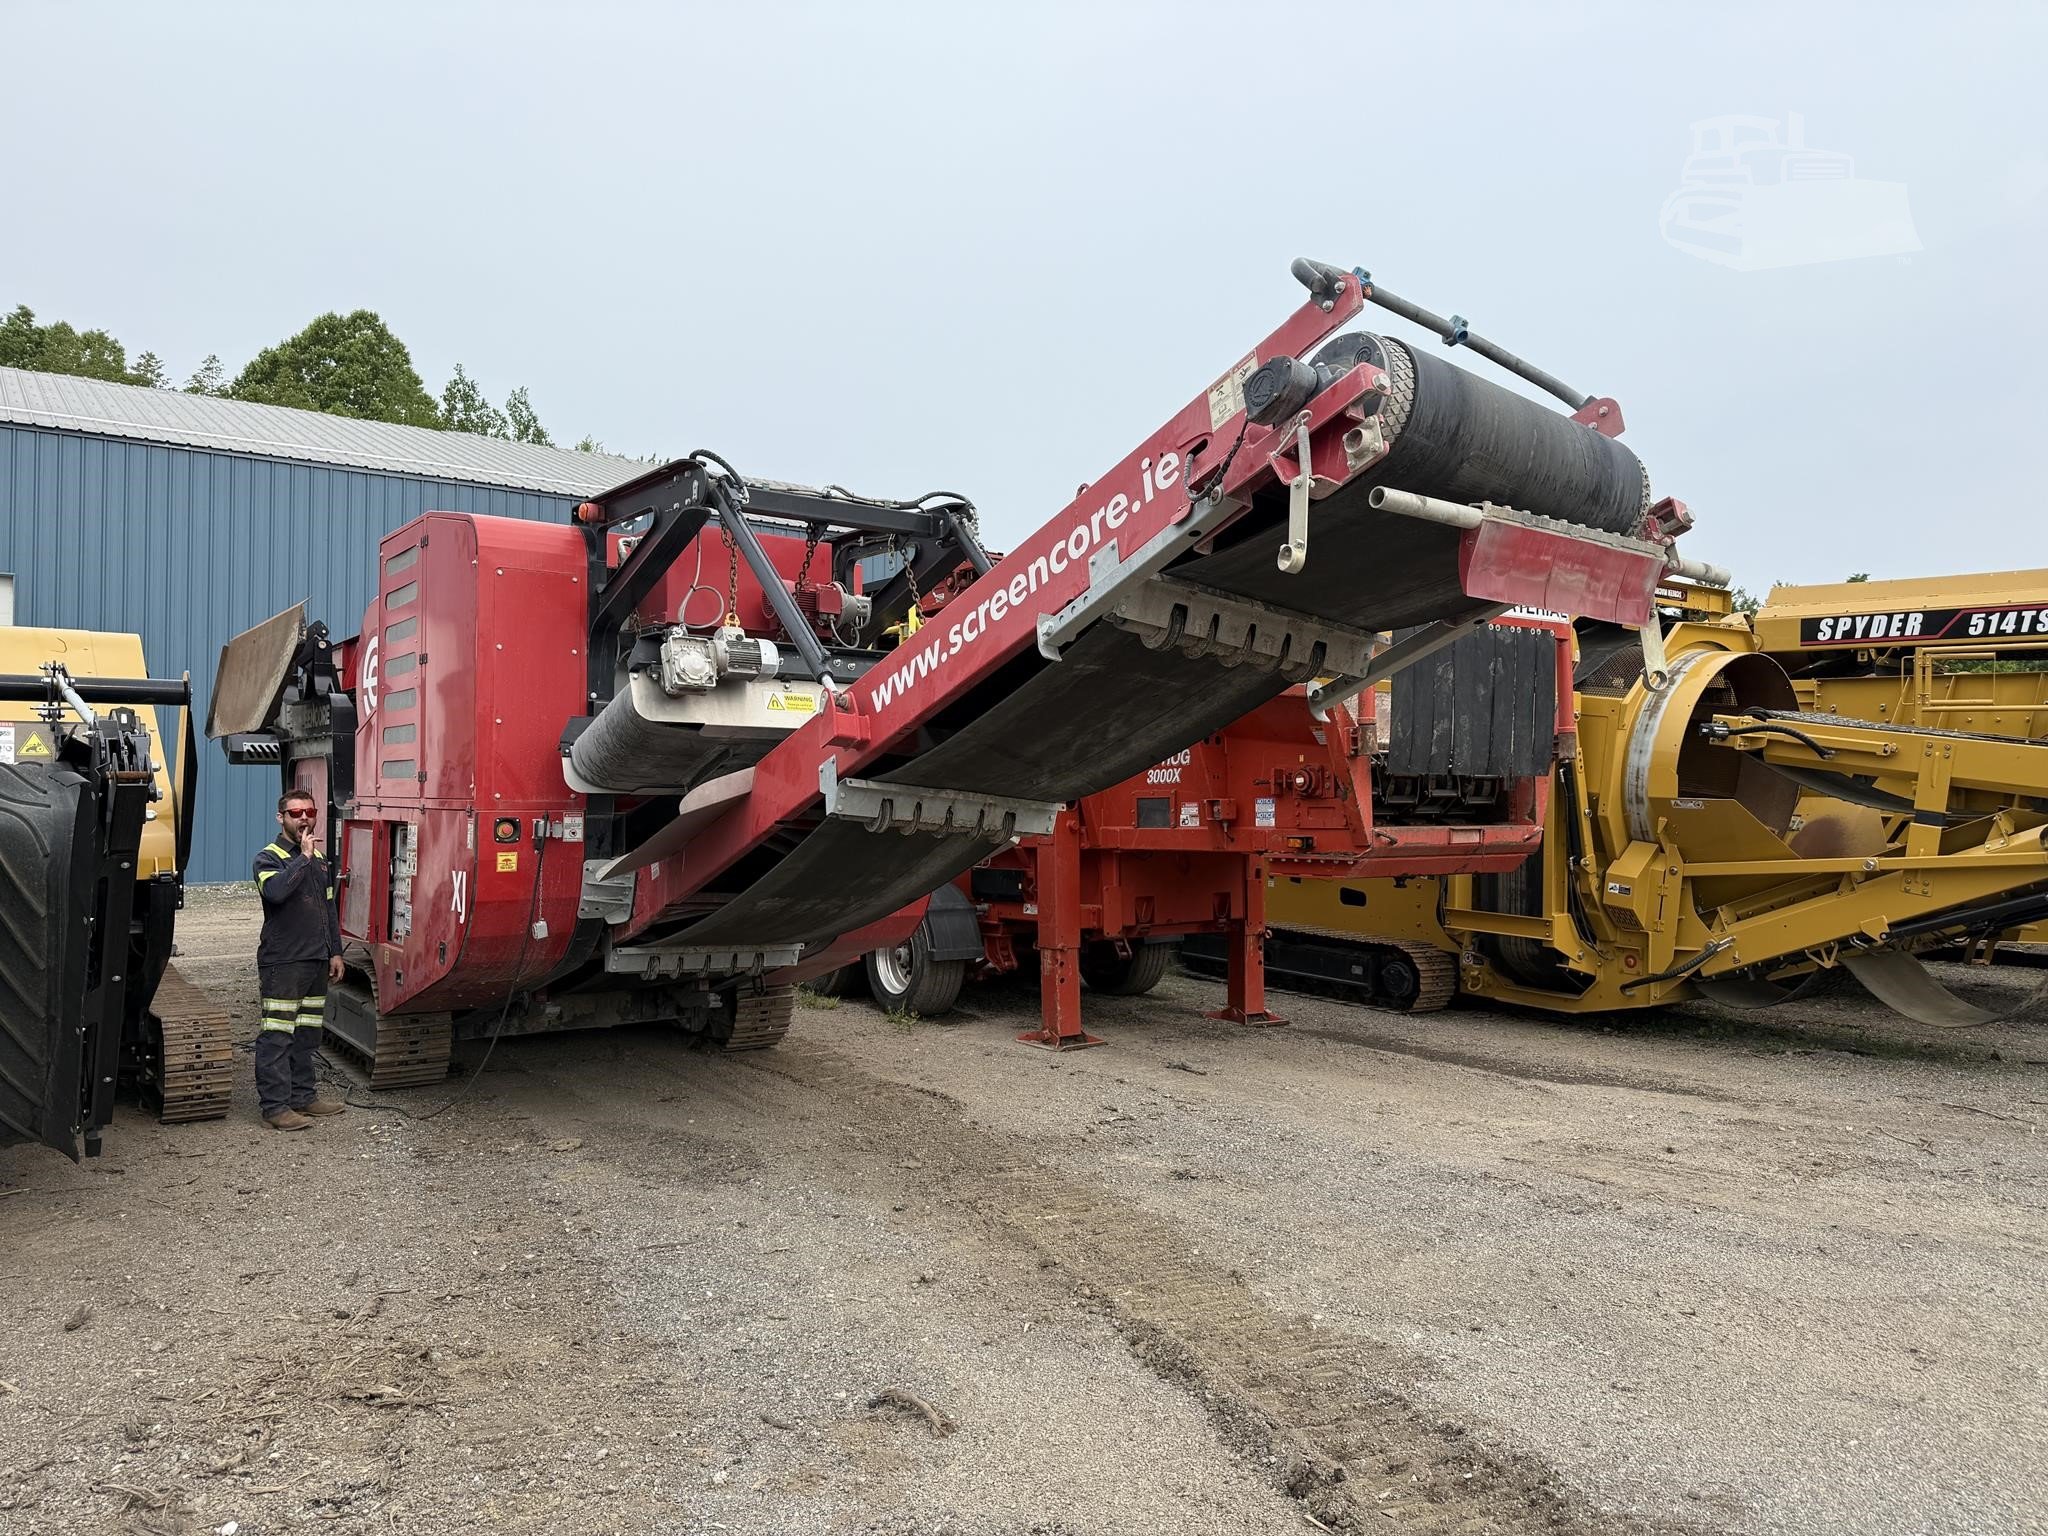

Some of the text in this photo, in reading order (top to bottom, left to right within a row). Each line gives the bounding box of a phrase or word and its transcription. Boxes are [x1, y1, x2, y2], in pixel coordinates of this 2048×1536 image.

[871, 451, 1180, 713] www.screencore.ie
[1817, 609, 2048, 641] SPYDER 514TS
[1146, 768, 1181, 784] 3000X
